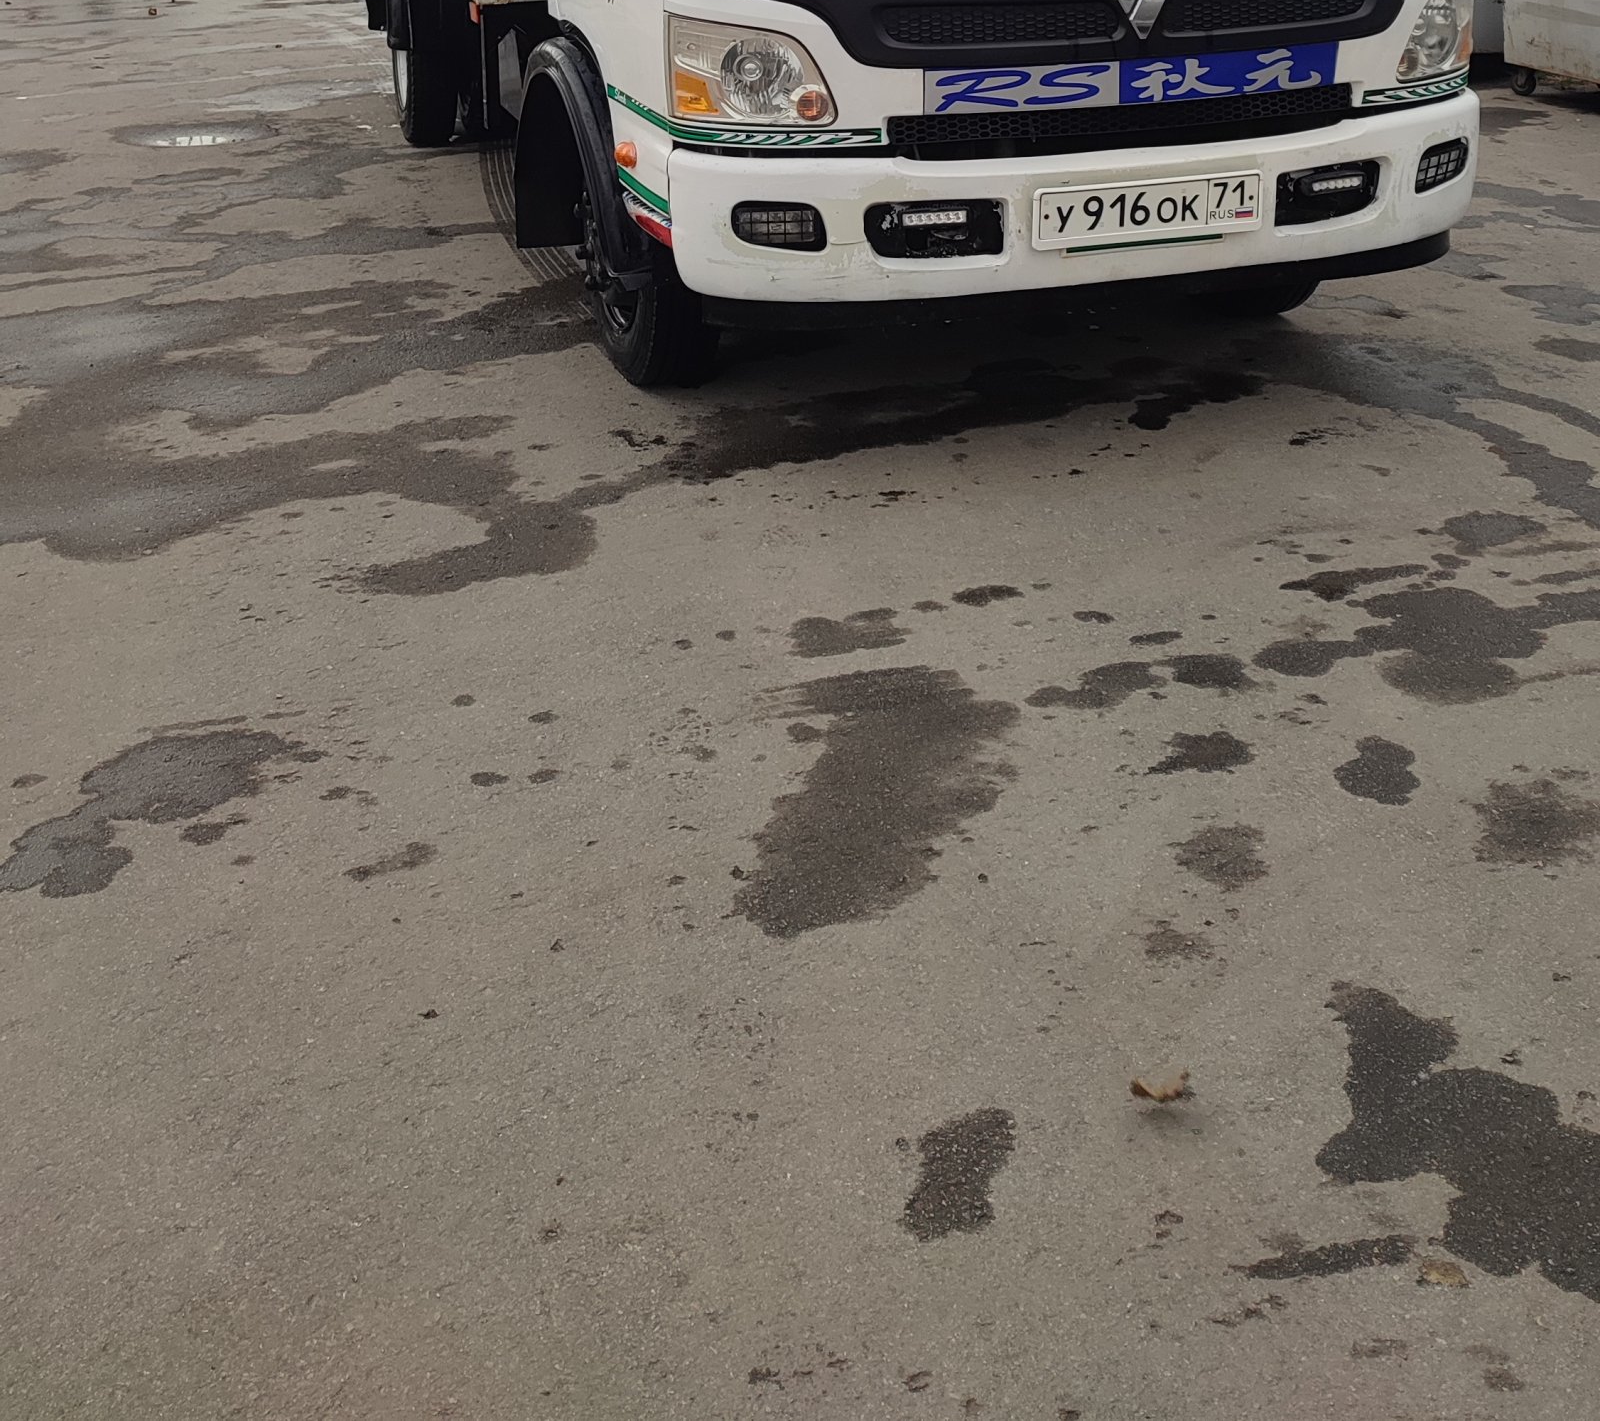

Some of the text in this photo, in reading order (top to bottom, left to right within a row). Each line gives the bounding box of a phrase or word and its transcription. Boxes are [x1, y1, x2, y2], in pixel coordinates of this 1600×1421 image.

[935, 65, 1111, 113] RS
[1130, 48, 1322, 102] 秋元
[1056, 180, 1246, 233] У916ОК 71
[1209, 209, 1235, 221] RUS
